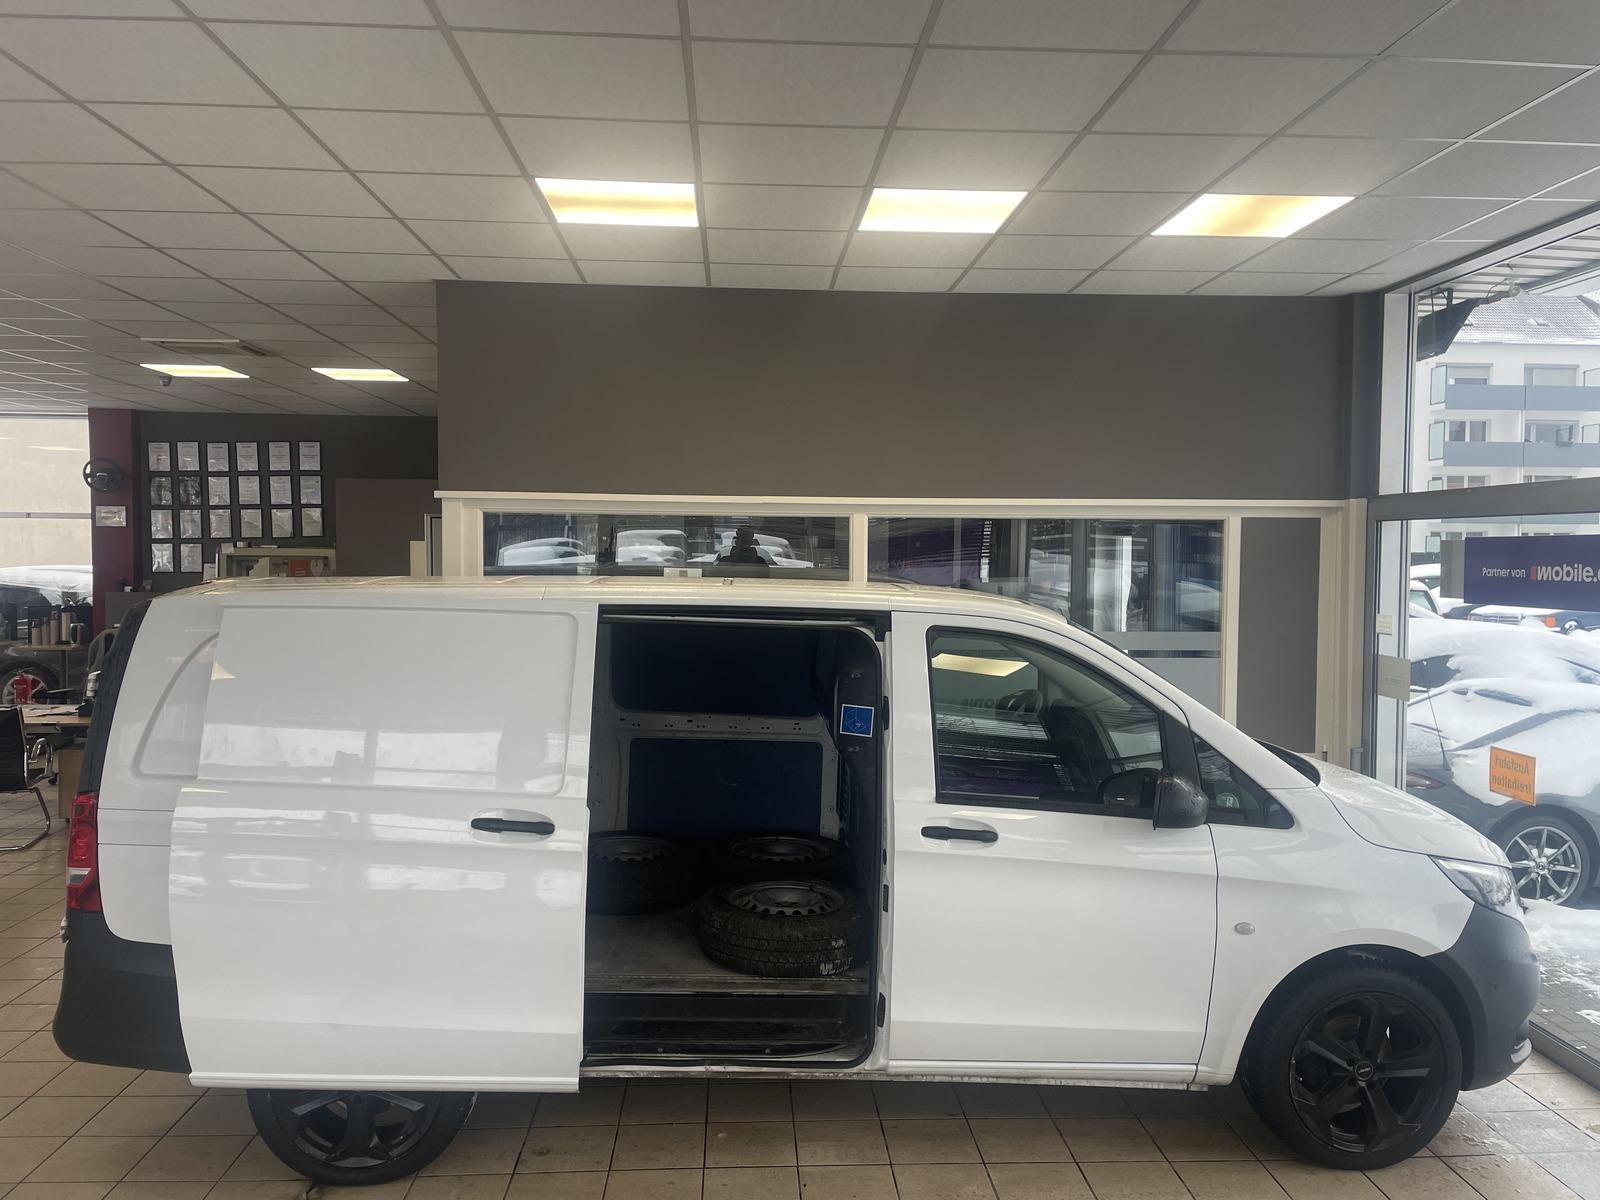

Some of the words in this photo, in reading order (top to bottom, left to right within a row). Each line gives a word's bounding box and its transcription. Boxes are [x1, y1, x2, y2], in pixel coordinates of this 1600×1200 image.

[1482, 567, 1510, 577] Partner
[1511, 568, 1526, 578] von
[1537, 563, 1600, 582] mobile.
